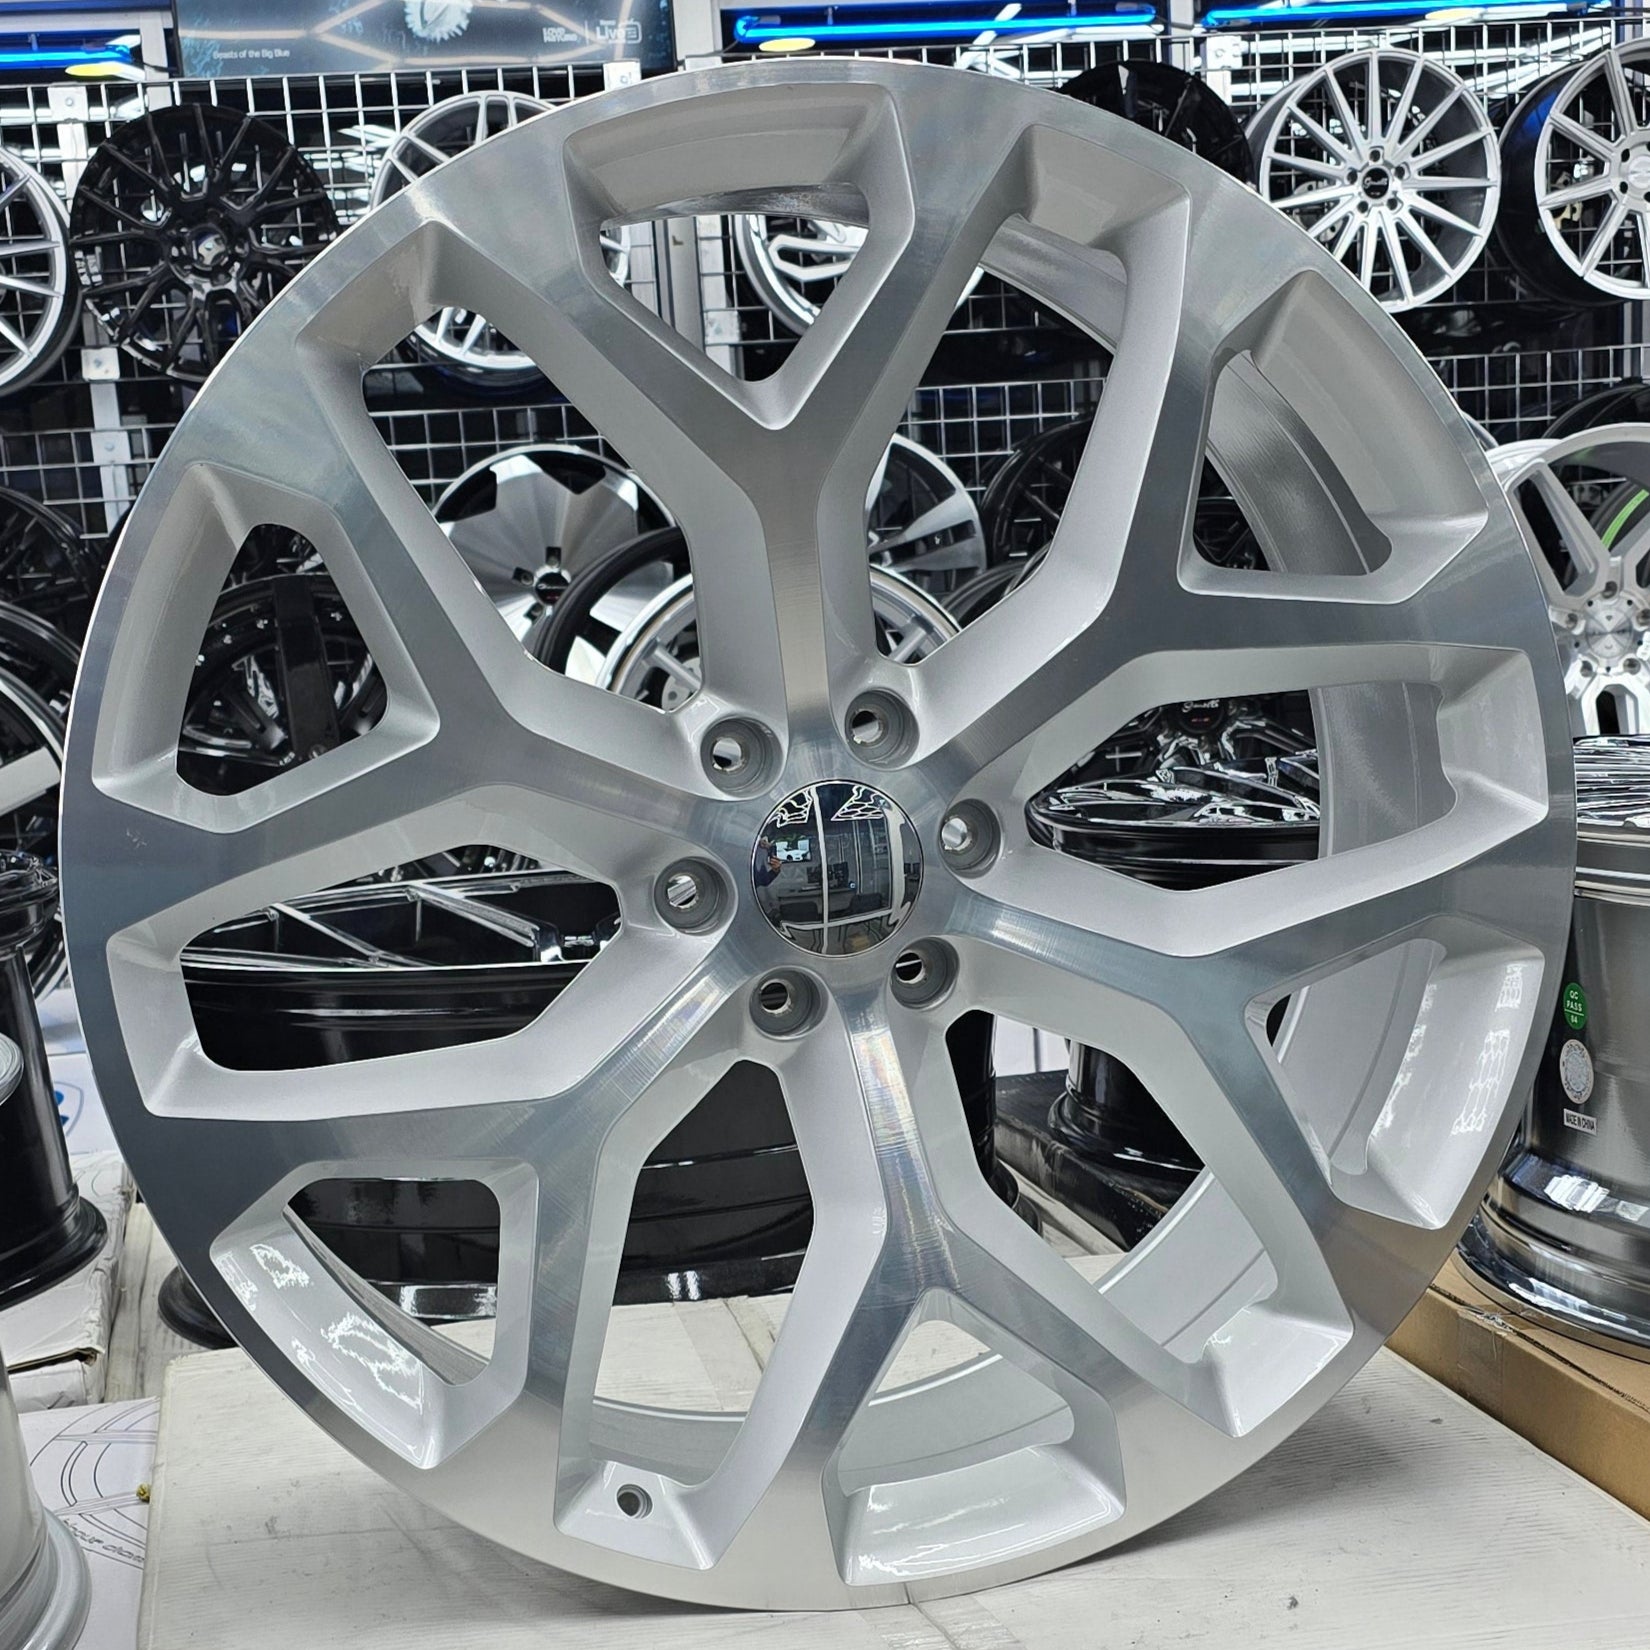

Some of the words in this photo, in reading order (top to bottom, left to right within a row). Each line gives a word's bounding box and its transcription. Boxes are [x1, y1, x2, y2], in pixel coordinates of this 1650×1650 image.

[239, 49, 247, 59] of
[248, 49, 260, 59] the
[261, 48, 273, 60] Big
[274, 48, 290, 58] Blue
[1569, 990, 1579, 1000] QC
[1566, 1000, 1583, 1012] PASS
[1565, 1111, 1577, 1126] MADE
[1582, 1116, 1595, 1131] CHINA
